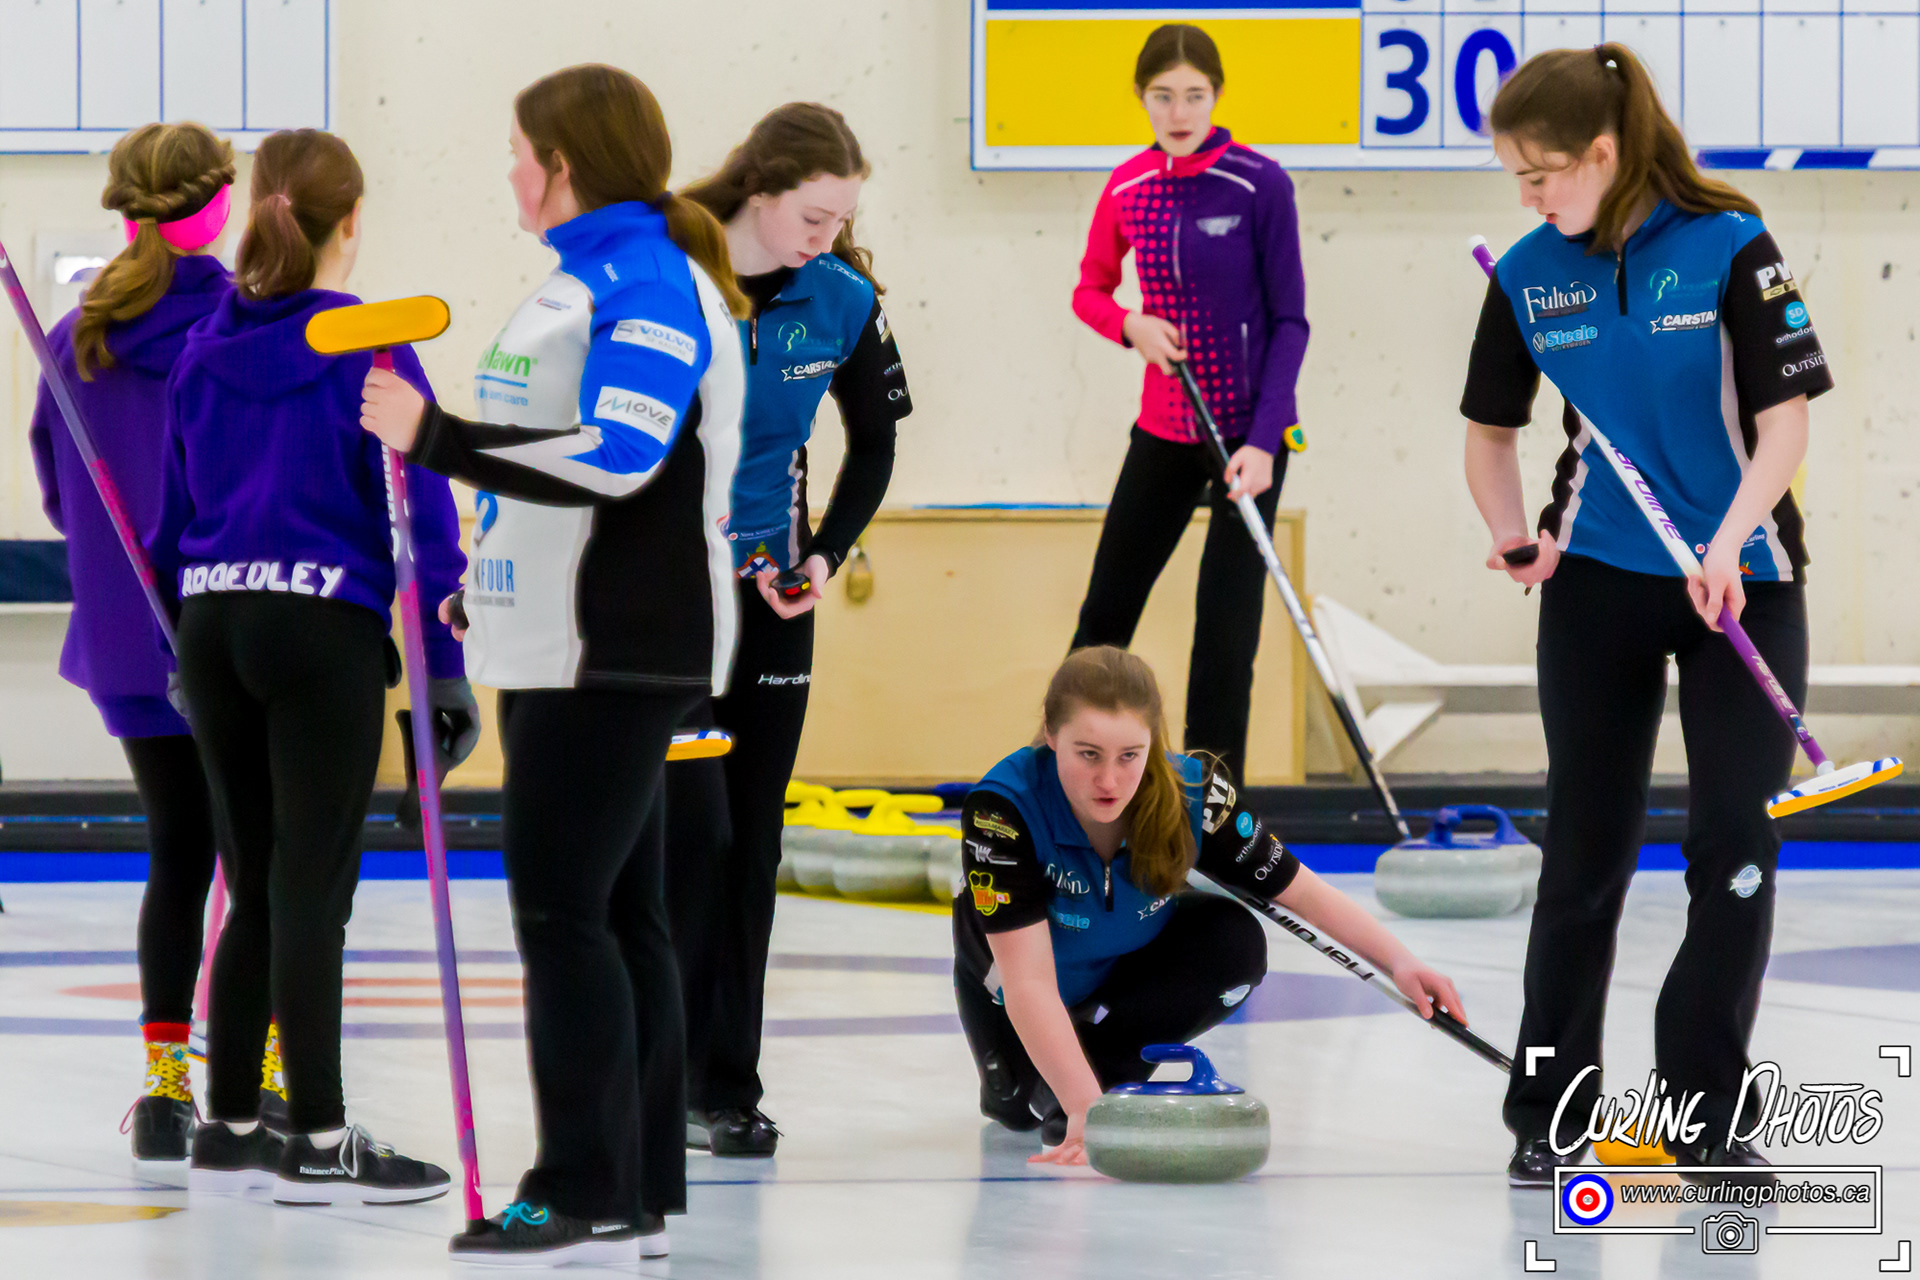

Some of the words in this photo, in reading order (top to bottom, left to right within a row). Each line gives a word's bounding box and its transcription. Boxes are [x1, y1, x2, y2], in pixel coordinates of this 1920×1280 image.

[1376, 28, 1429, 136] 3
[1522, 281, 1597, 324] Fulton
[1788, 307, 1804, 319] SD
[638, 325, 695, 352] VOLVO
[1545, 325, 1598, 347] Steele
[598, 396, 673, 427] MOVE
